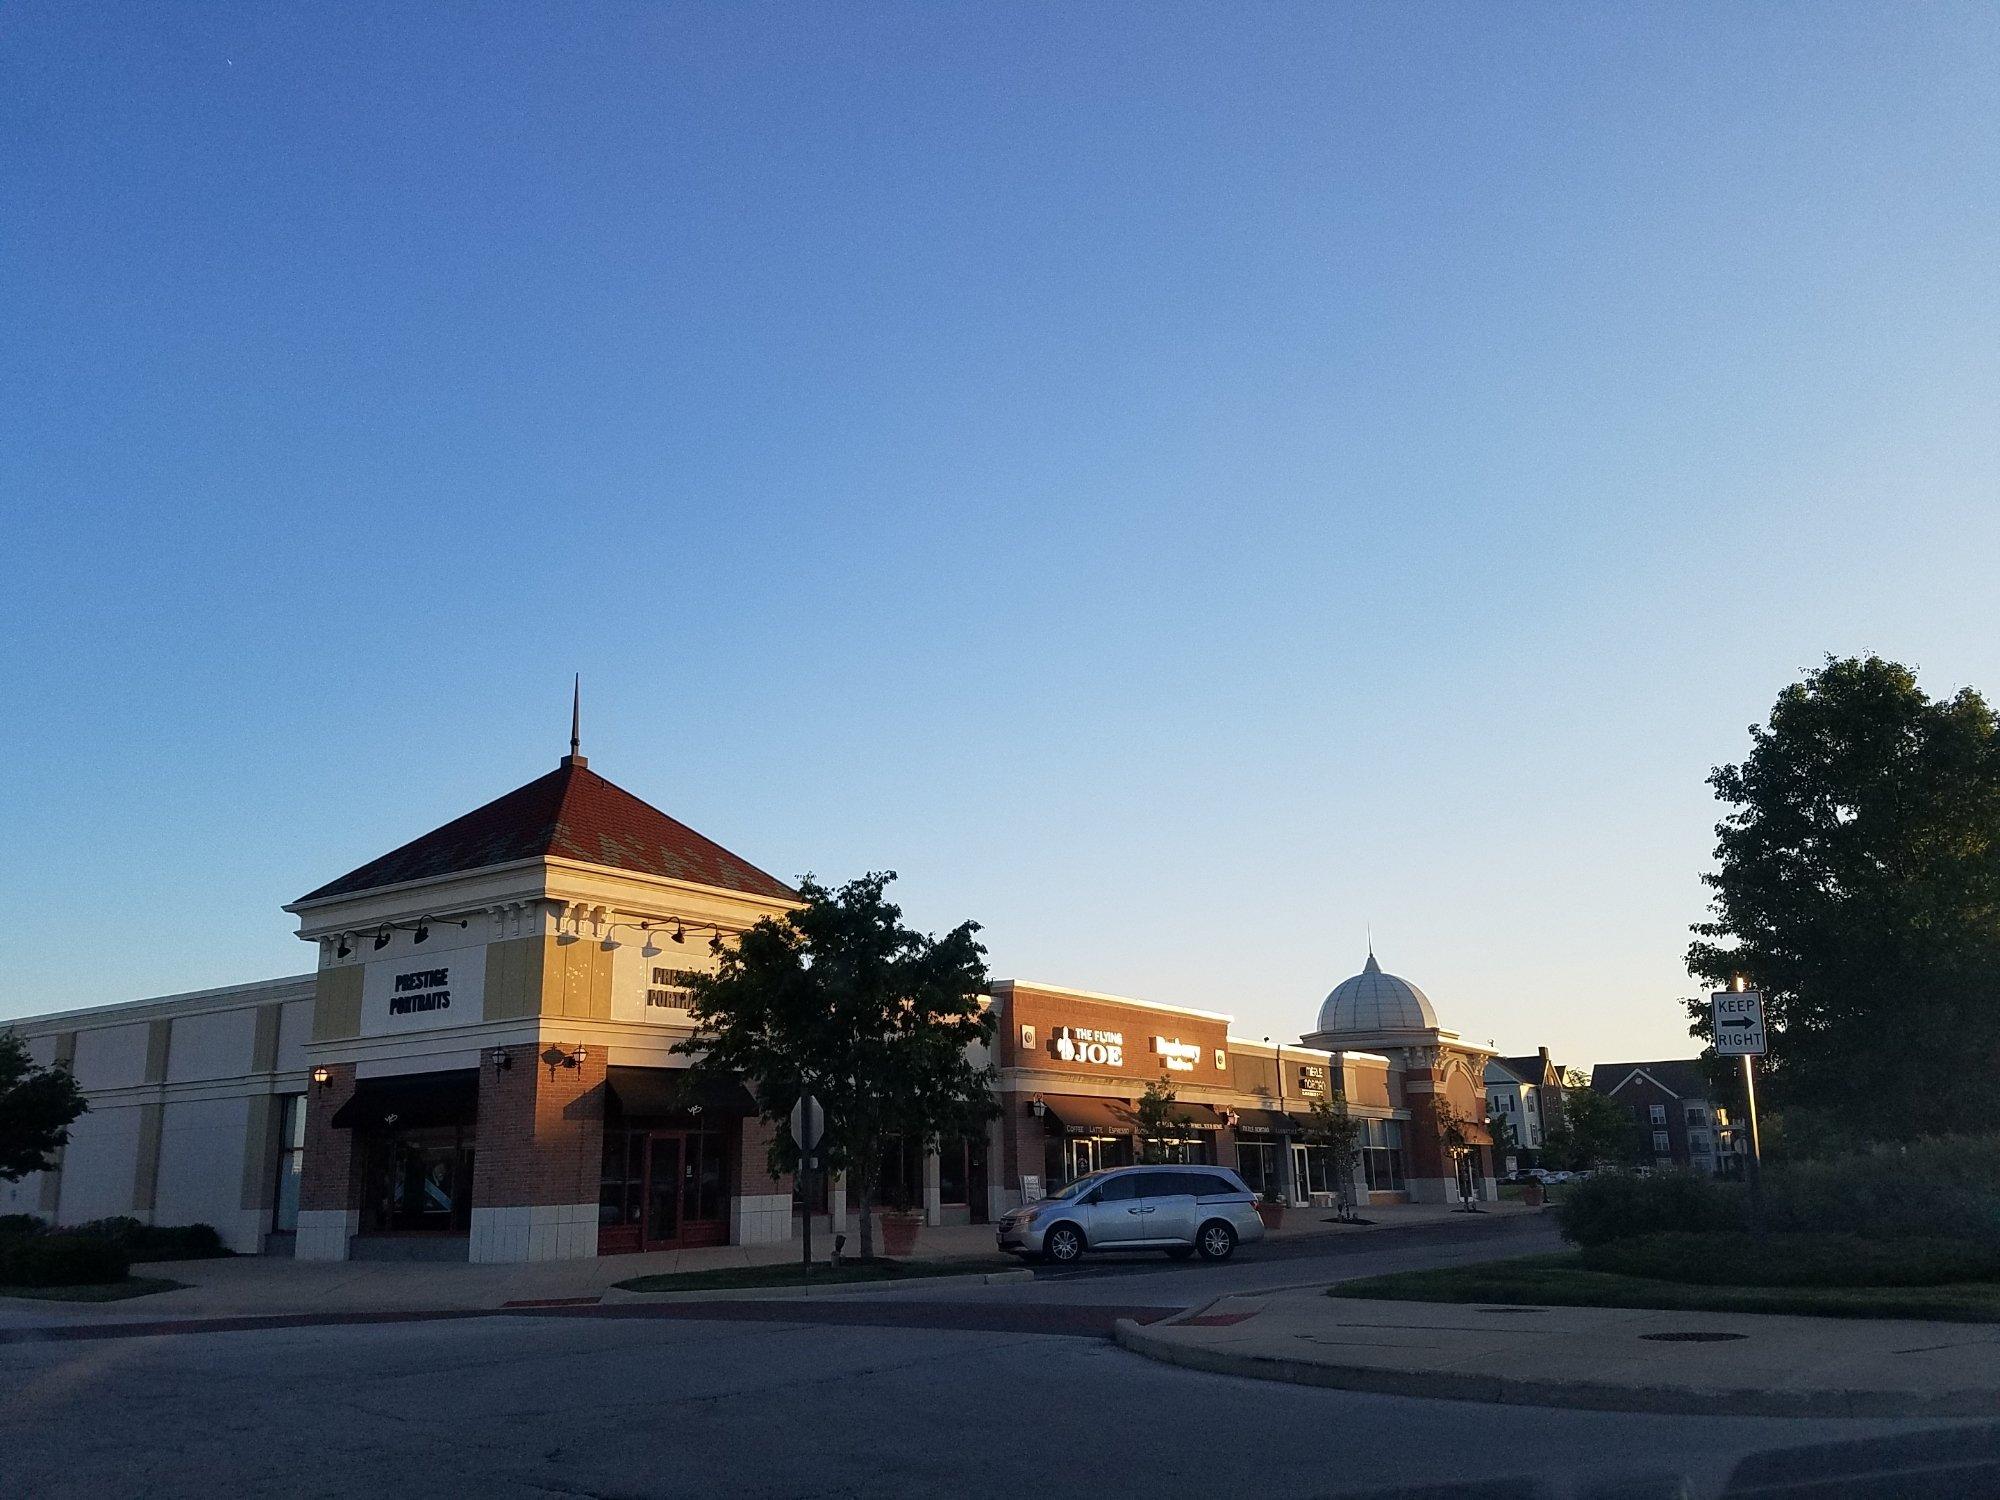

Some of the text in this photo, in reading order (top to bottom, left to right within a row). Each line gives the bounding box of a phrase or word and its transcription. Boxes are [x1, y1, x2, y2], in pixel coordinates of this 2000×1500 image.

[395, 967, 449, 992] PRESTIGE
[389, 990, 451, 1015] PORTRAITS
[1718, 1000, 1755, 1013] KEEP
[1075, 1027, 1123, 1046] THE FLYING
[1718, 1033, 1761, 1046] RIGHT
[1074, 1042, 1123, 1067] JOE
